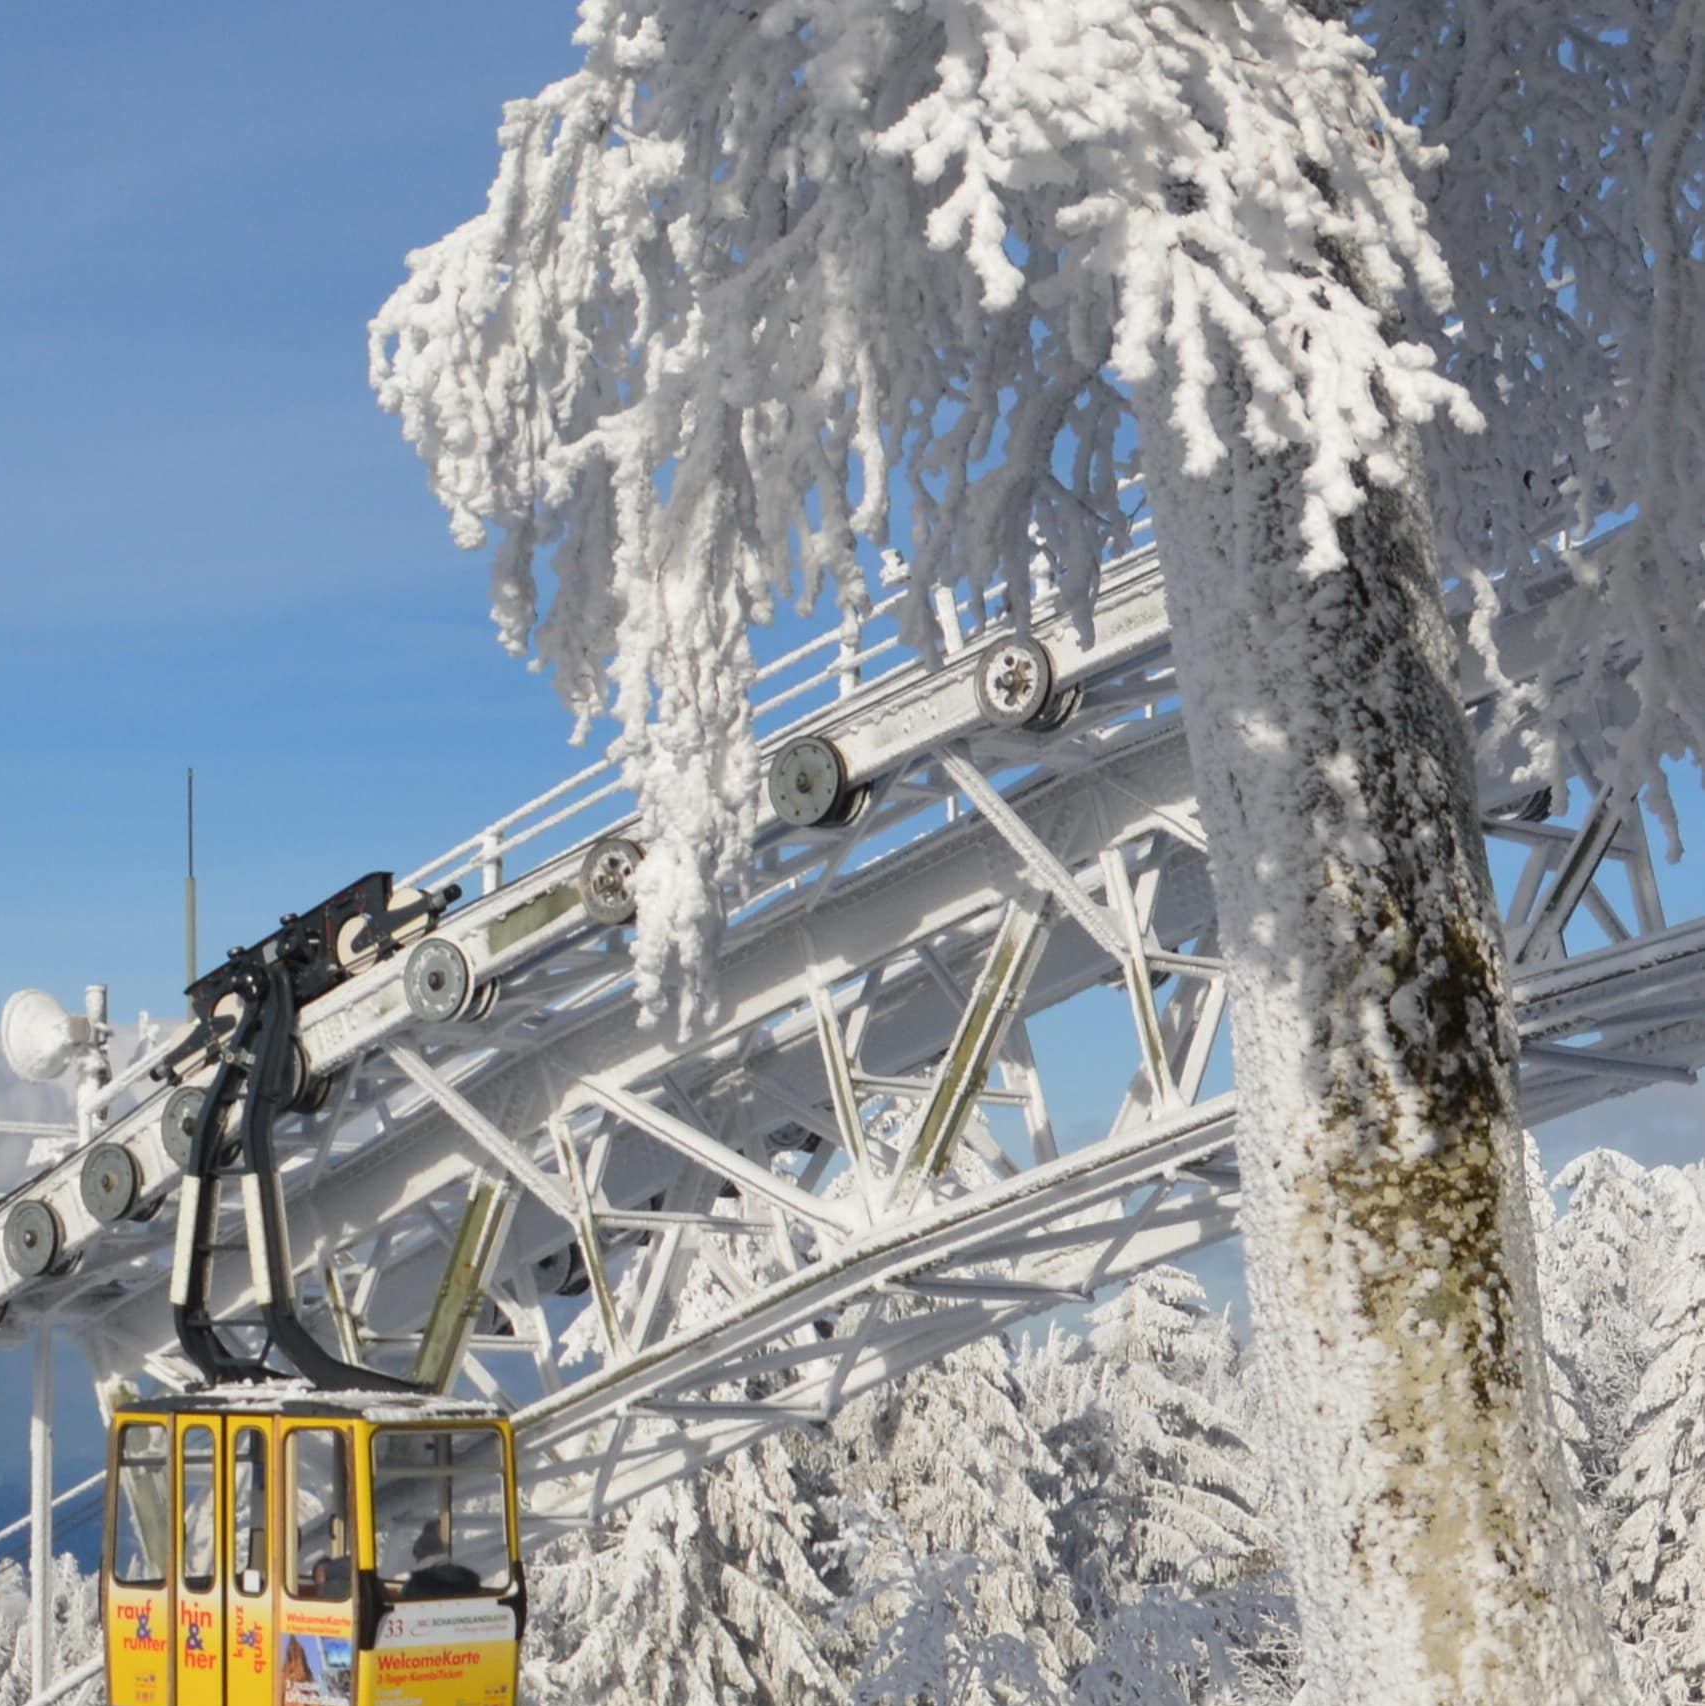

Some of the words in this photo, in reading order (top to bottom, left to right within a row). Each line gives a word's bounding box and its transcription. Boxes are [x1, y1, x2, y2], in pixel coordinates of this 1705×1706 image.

[117, 1599, 153, 1620] rauf
[181, 1600, 213, 1628] hin
[136, 1613, 152, 1639] &
[186, 1623, 204, 1651] &
[384, 1618, 404, 1639] 33
[123, 1635, 166, 1652] runter
[242, 1630, 256, 1648] &
[253, 1621, 267, 1674] quer
[184, 1646, 217, 1671] her
[377, 1649, 481, 1671] WelcomeKarte
